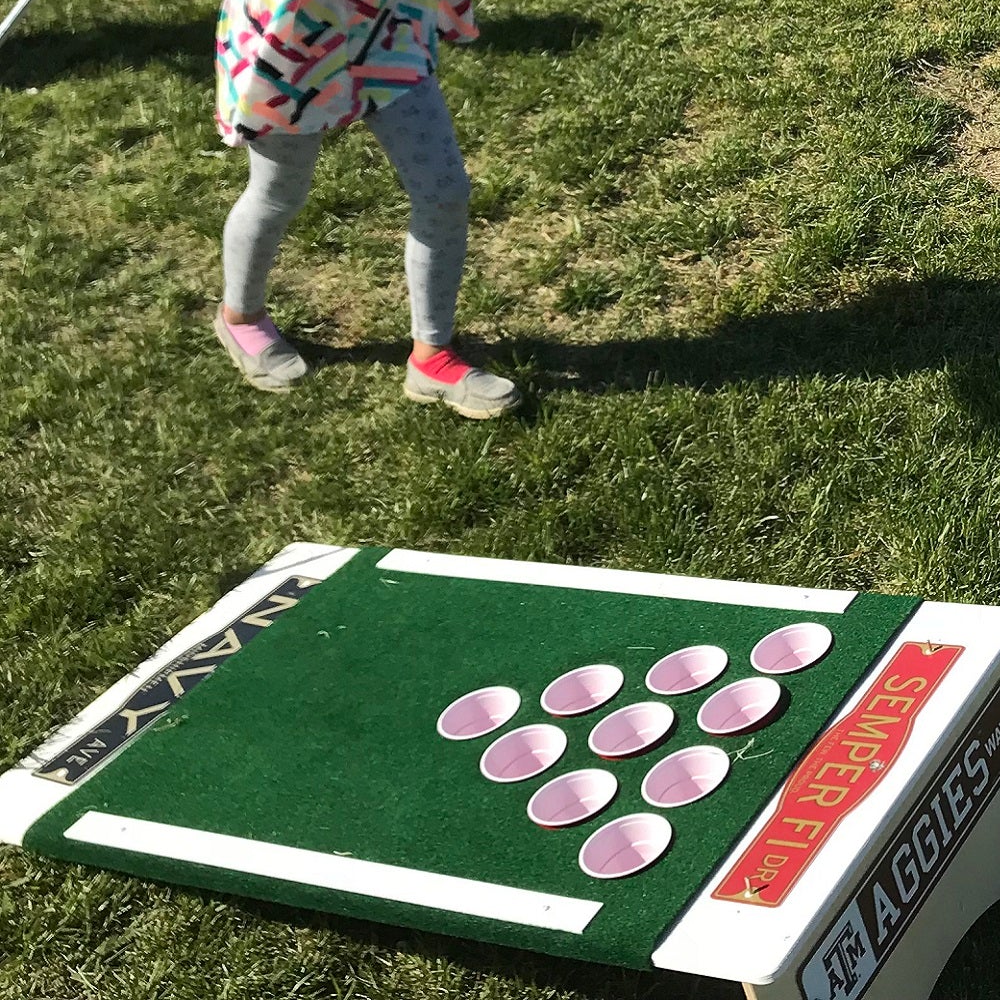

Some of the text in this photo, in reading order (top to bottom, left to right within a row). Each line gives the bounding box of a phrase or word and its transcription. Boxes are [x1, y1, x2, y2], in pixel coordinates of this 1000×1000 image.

[118, 594, 299, 738] NAVY
[755, 673, 927, 883] SEMPER FI DR
[871, 739, 990, 946] AGGIES
